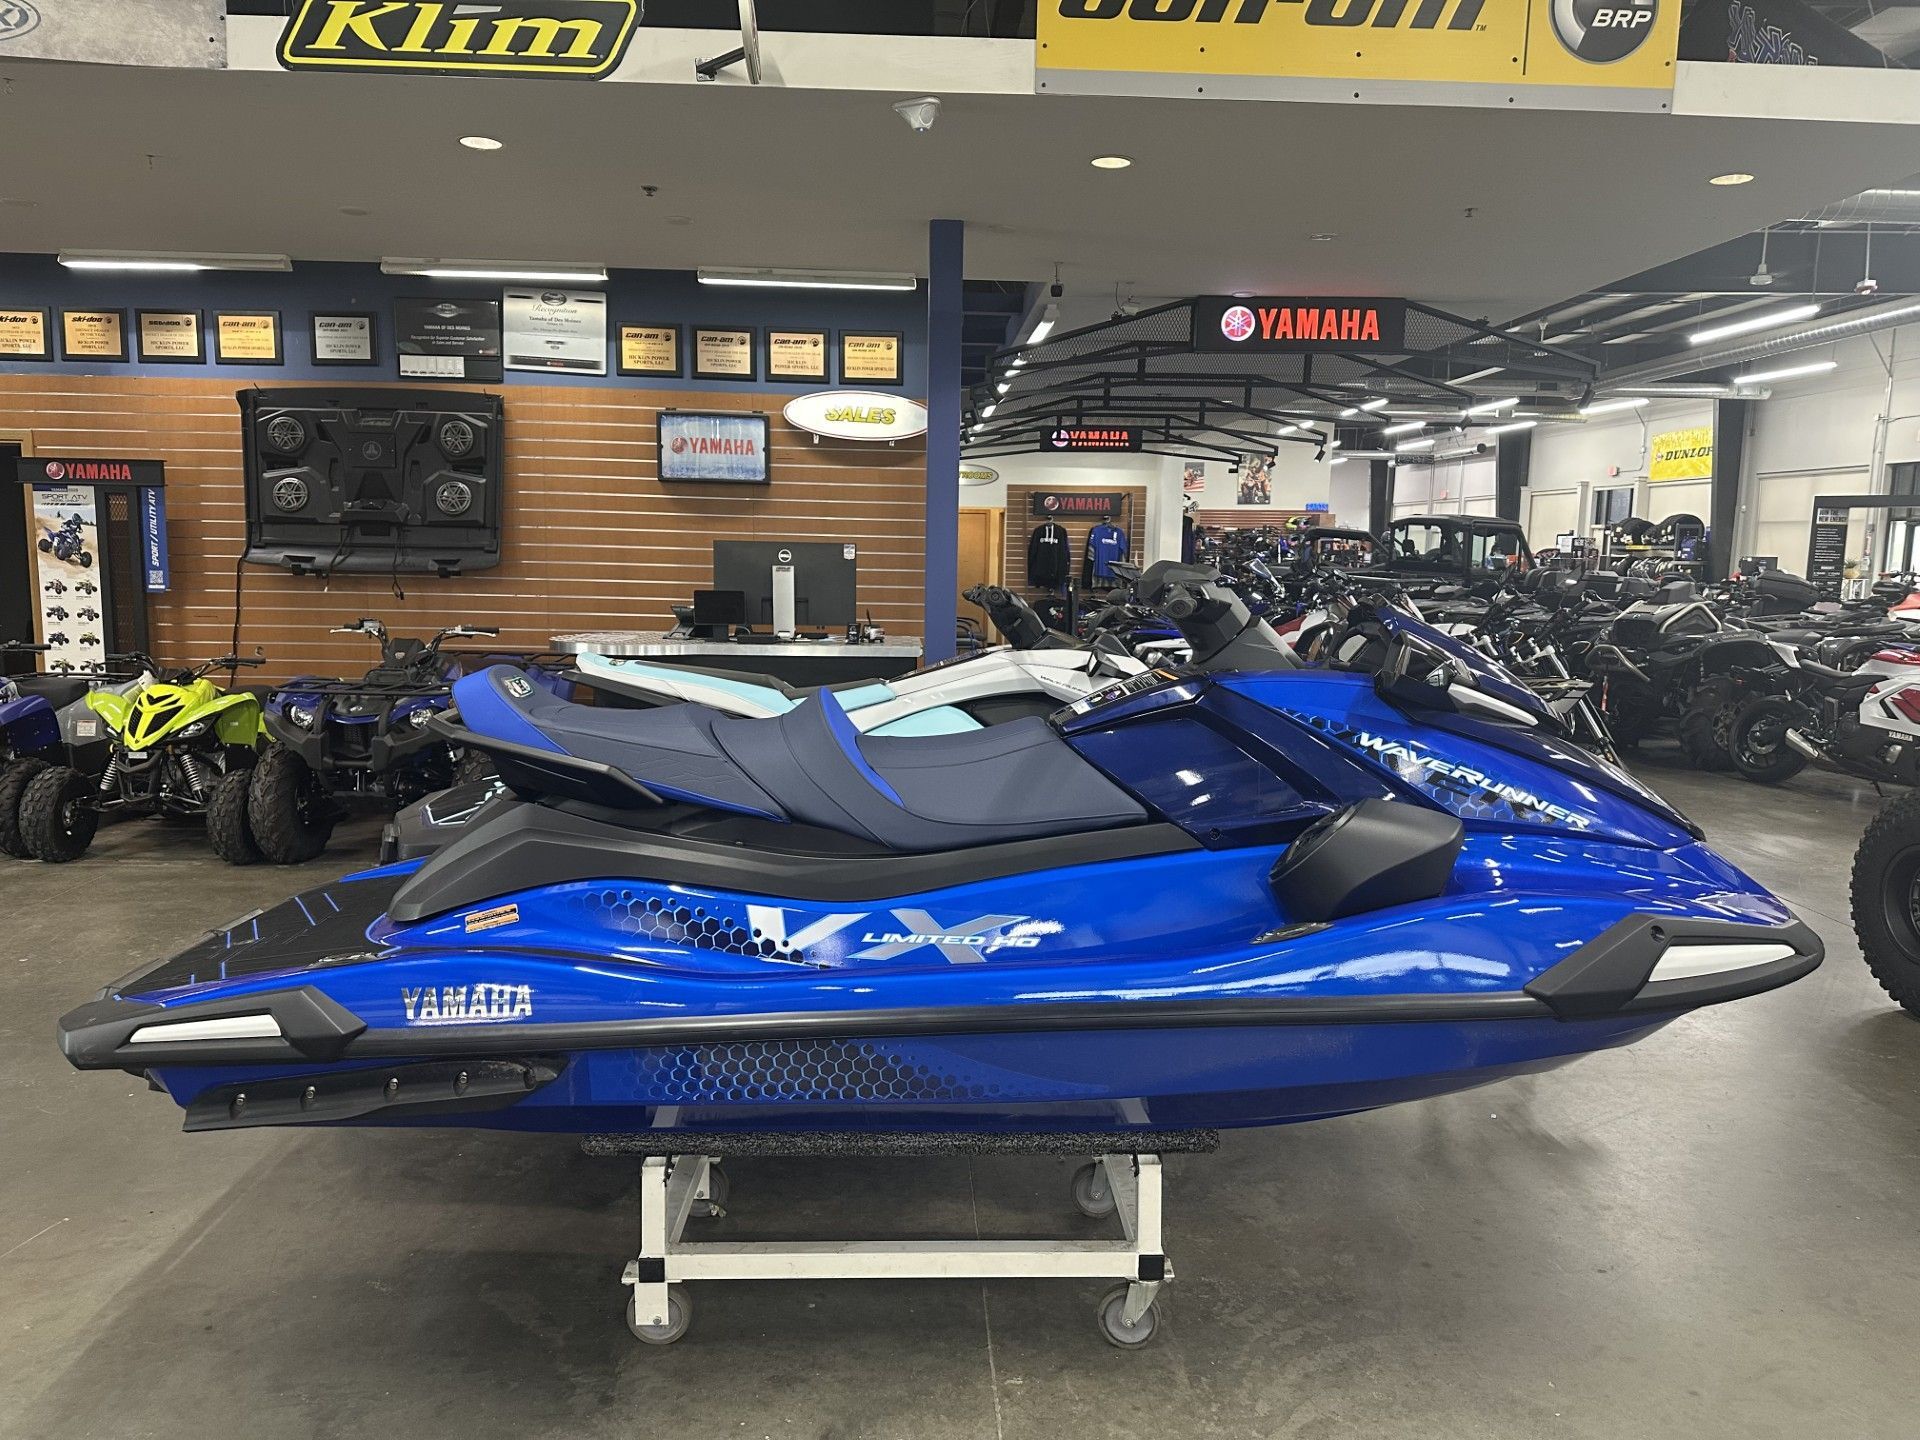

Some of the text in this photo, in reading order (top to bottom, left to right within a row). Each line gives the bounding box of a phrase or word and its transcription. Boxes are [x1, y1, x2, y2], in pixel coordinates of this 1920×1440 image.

[1591, 9, 1652, 29] BRP
[304, 0, 603, 58] Klim
[1258, 308, 1380, 341] YAMAHA
[824, 405, 896, 424] SALES
[690, 437, 755, 456] YAMAHA
[64, 462, 132, 480] YAMAHA
[147, 489, 156, 506] ATV
[1060, 497, 1111, 511] YAMAHA
[148, 505, 158, 535] UTILITY
[150, 541, 160, 568] SPORT
[1888, 730, 1914, 742] YAMAHA
[861, 932, 985, 945] LIMITED
[400, 984, 533, 1020] YAMAHA
